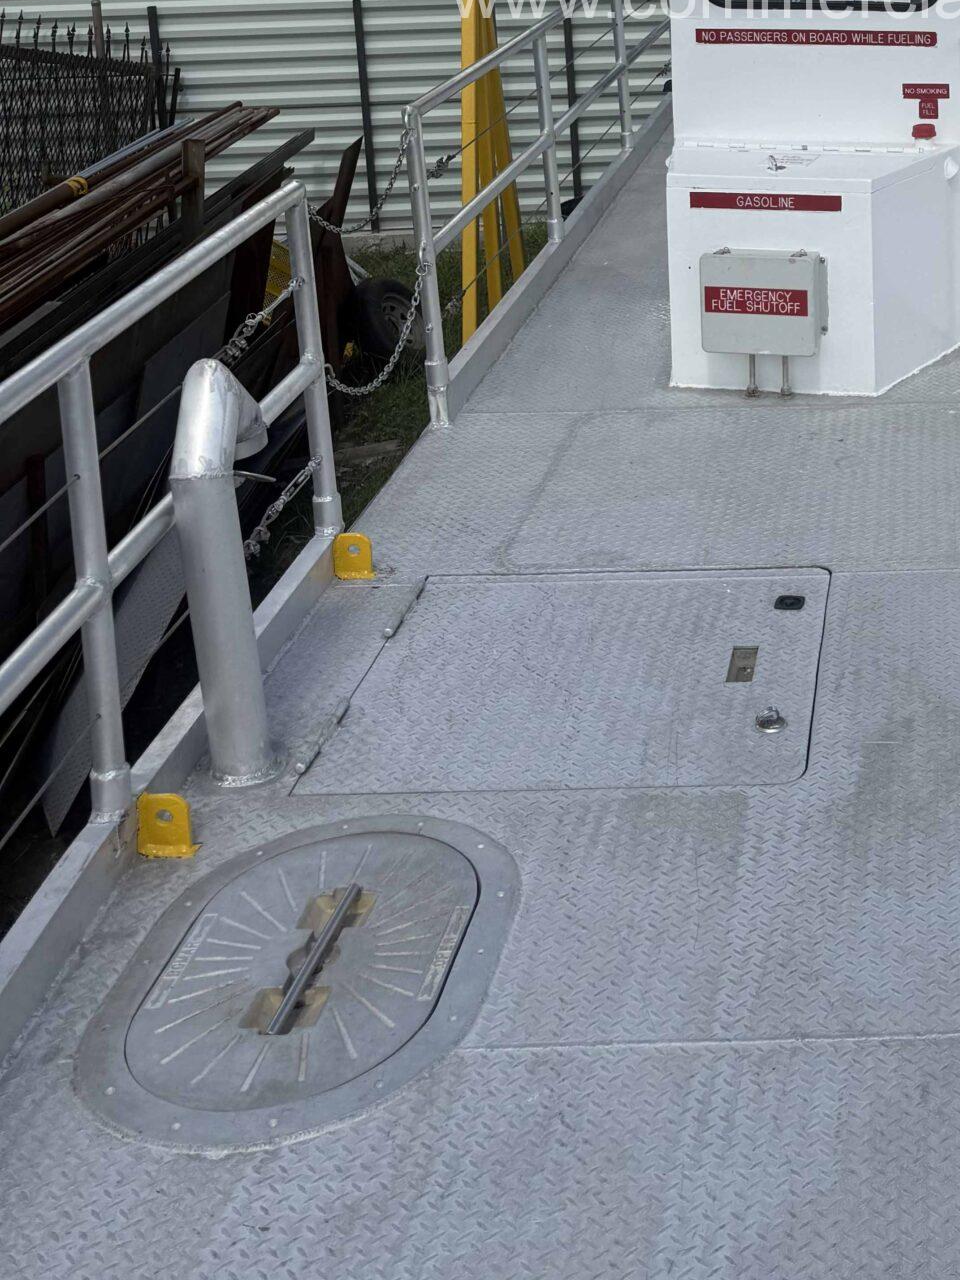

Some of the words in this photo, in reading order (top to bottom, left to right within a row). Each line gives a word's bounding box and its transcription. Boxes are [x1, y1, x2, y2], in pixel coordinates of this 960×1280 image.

[702, 31, 717, 41] NO
[720, 31, 788, 43] PASSENGERS
[791, 32, 806, 43] ON
[809, 32, 848, 43] BOARD
[851, 33, 884, 44] WHILE
[888, 34, 931, 45] FUELING
[736, 196, 796, 208] GASOLINE
[720, 289, 792, 302] EMERGENCY
[711, 300, 742, 312] FUEL
[746, 301, 801, 314] SHUTOFF
